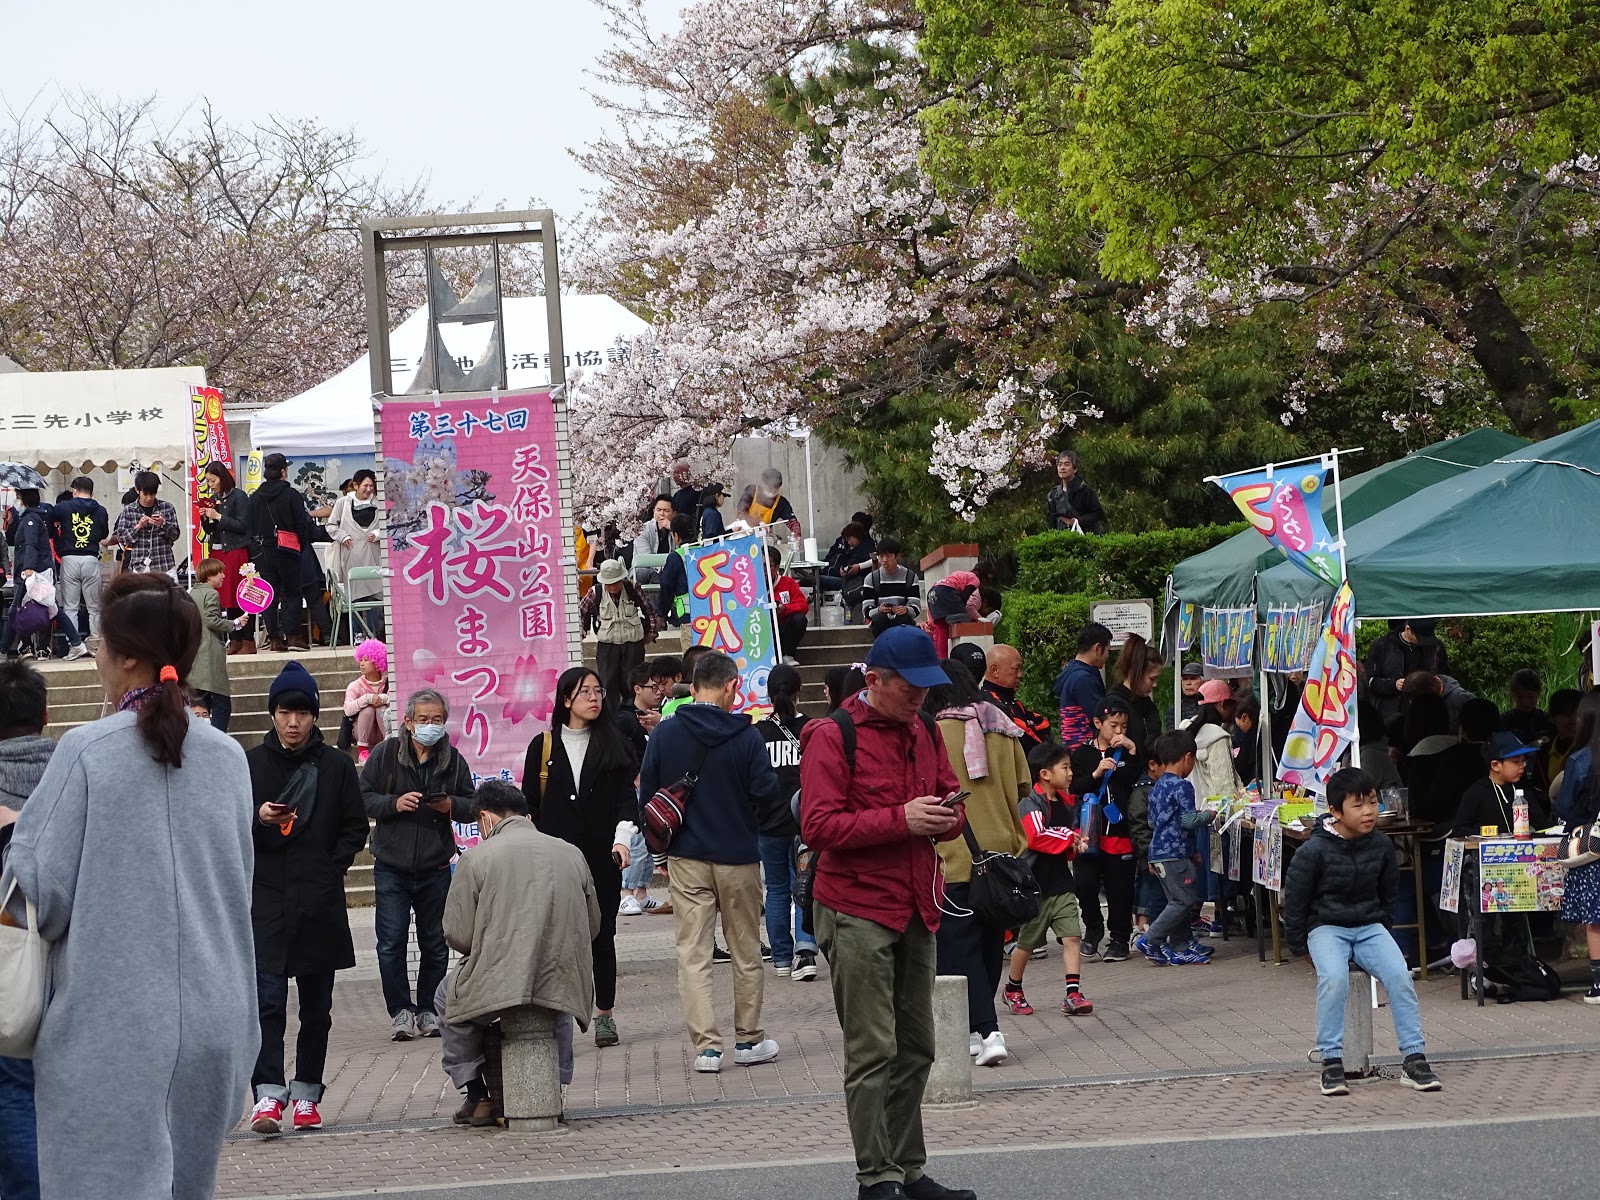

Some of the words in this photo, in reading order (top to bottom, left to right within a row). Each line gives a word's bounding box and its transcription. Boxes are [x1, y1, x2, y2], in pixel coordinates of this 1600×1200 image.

[0, 407, 164, 430] 三先小学校
[409, 409, 528, 439] 第三十七回
[511, 446, 553, 639] 天保山公園
[407, 505, 518, 757] 桜まつり
